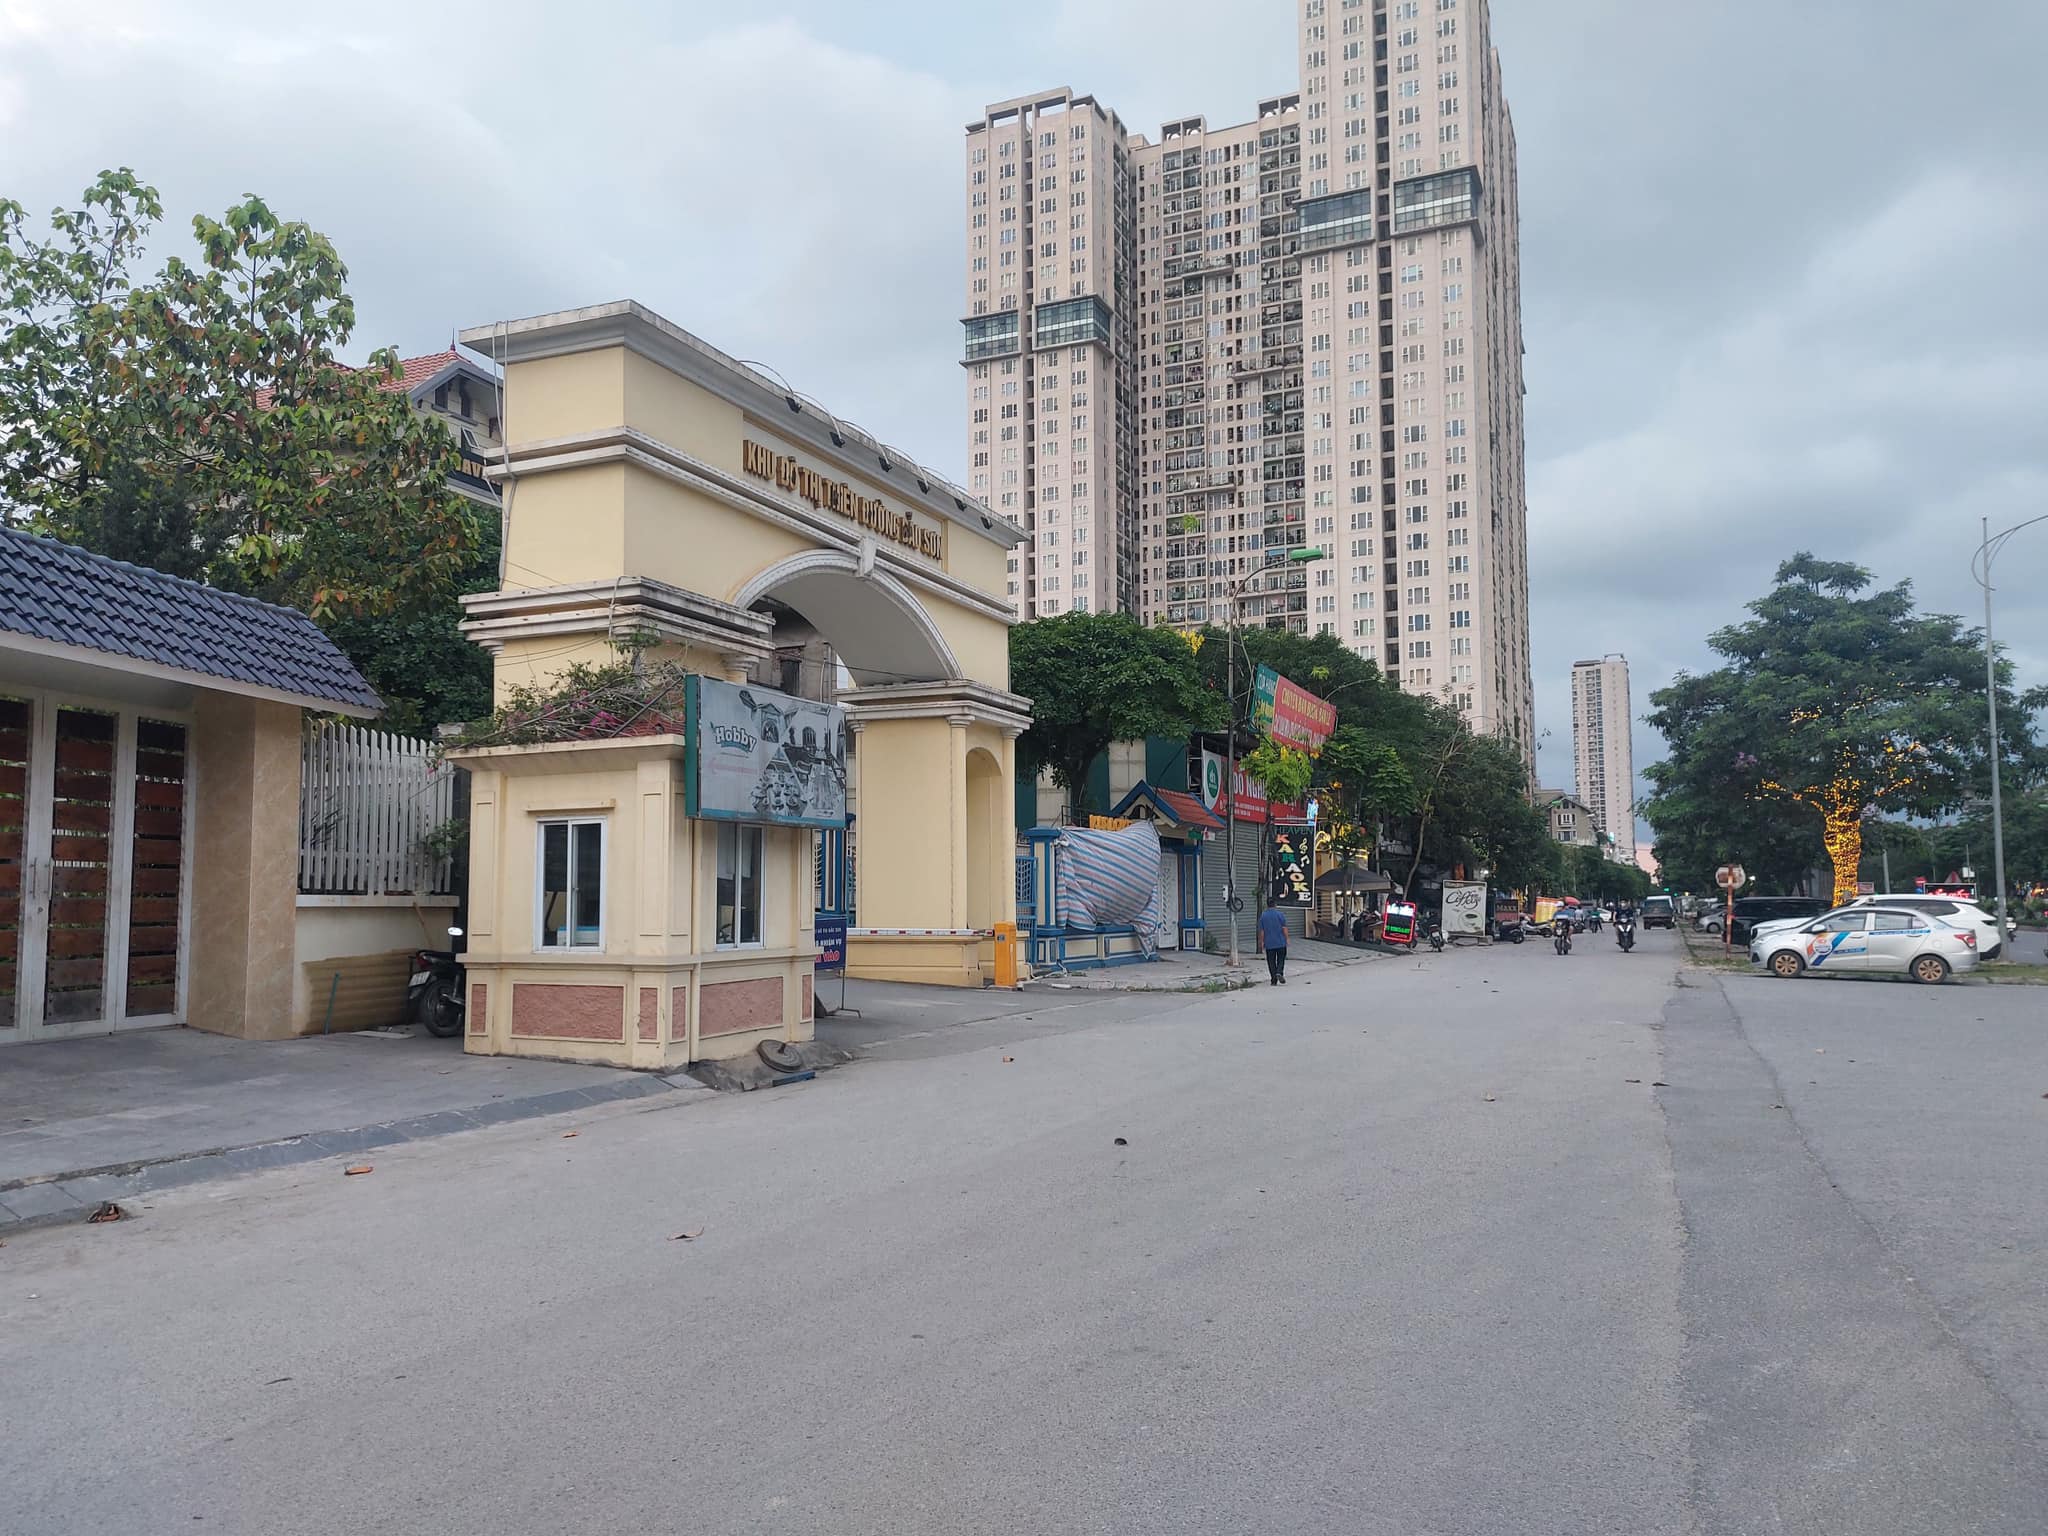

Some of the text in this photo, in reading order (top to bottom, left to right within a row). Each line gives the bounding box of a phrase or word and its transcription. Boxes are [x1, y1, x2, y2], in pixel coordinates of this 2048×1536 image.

[743, 439, 775, 480] KHU
[776, 456, 799, 492] ĐÔ
[715, 726, 757, 753] Hobby
[1276, 825, 1314, 835] HEAVEN
[1275, 833, 1312, 902] KARAOKE
[823, 949, 840, 963] VÀO
